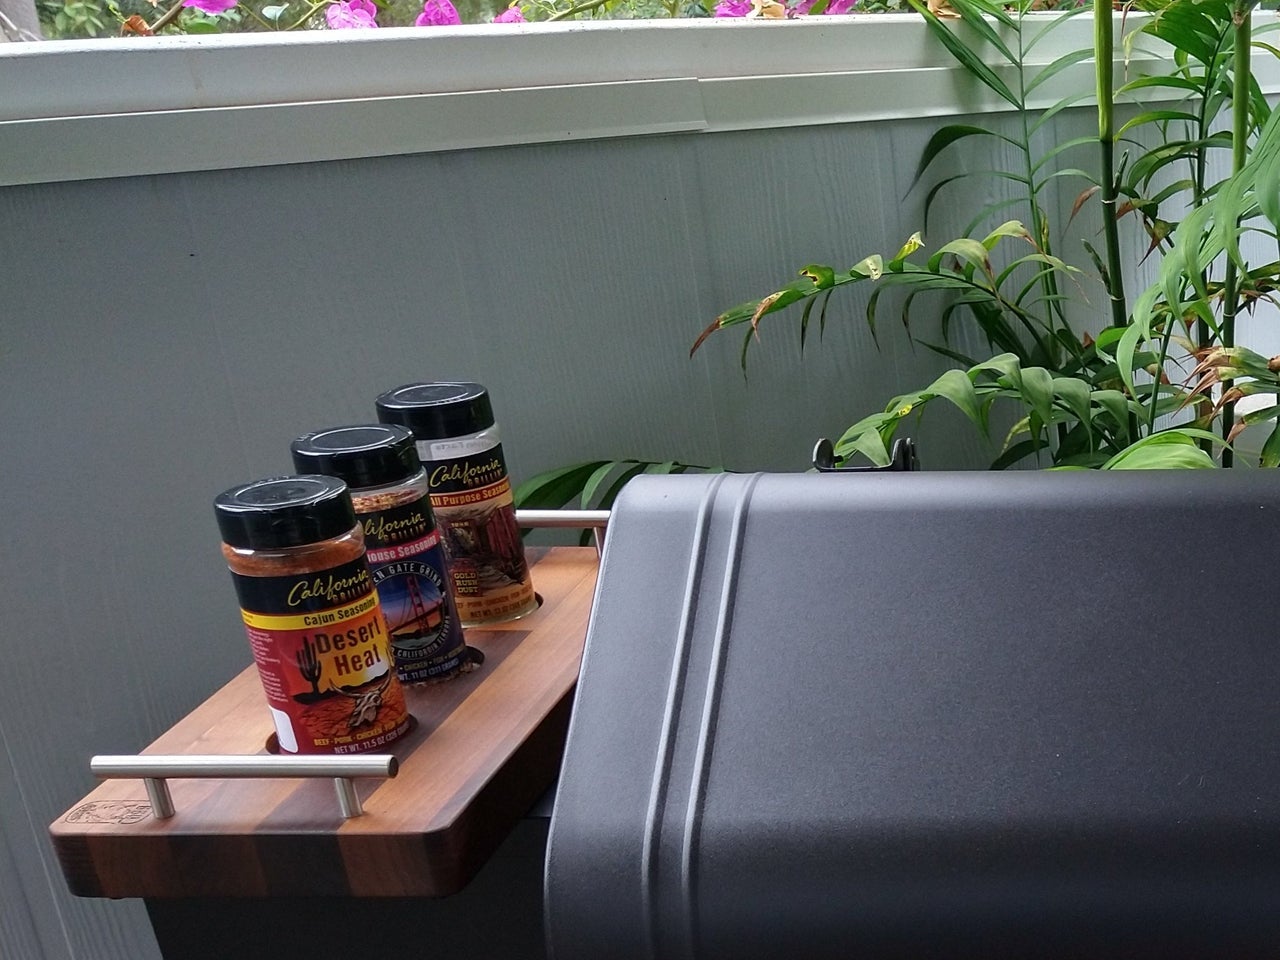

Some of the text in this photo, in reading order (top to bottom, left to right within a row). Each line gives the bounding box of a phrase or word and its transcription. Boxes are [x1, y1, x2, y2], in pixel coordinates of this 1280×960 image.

[430, 458, 501, 487] California
[444, 492, 481, 505] Purpose
[364, 512, 425, 540] lifornia
[397, 535, 437, 557] Seasoning
[389, 562, 415, 574] GATE
[288, 568, 369, 606] California
[304, 597, 376, 626] Cajun Seasoning
[315, 616, 381, 654] Desert
[333, 643, 381, 676] Heat
[334, 746, 348, 754] NET
[363, 739, 377, 749] 11.5
